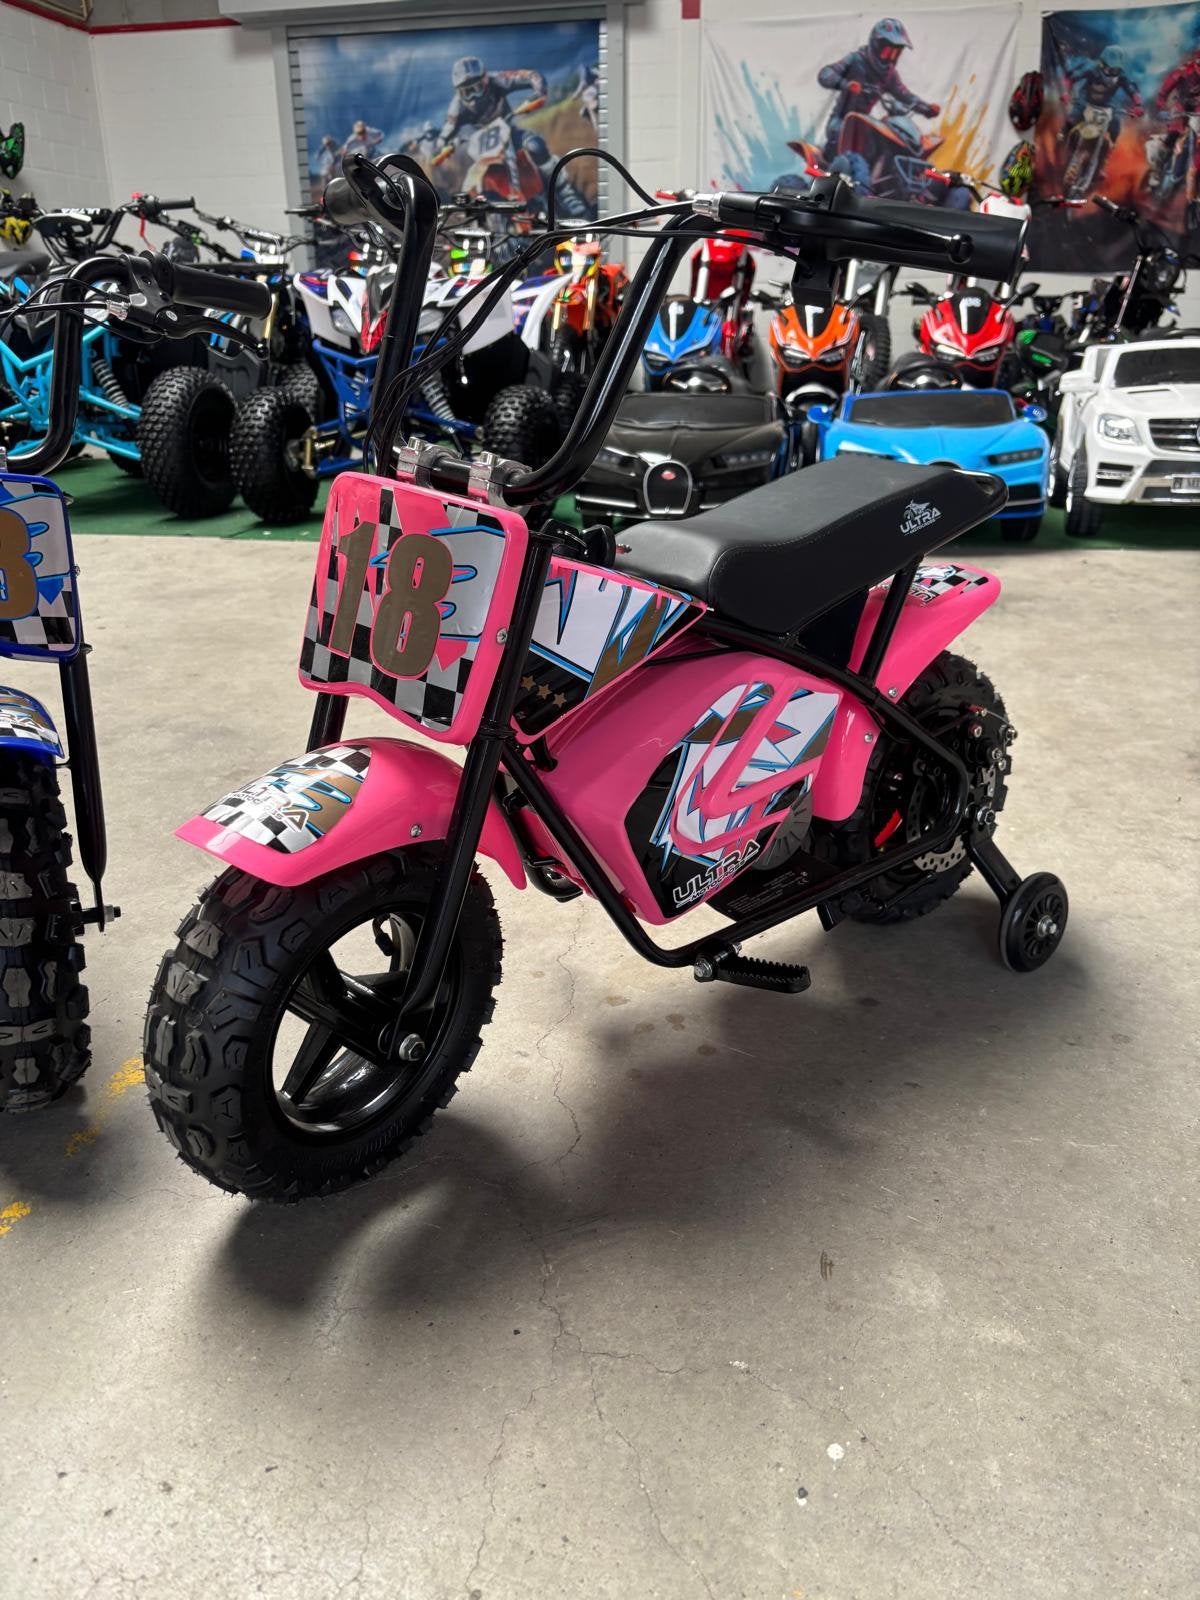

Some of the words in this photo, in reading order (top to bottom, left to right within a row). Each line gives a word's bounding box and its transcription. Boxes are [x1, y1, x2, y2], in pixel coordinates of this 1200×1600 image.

[479, 126, 501, 153] 18
[900, 507, 941, 534] ULTRA
[329, 520, 454, 680] 18
[673, 839, 761, 904] ULTRA
